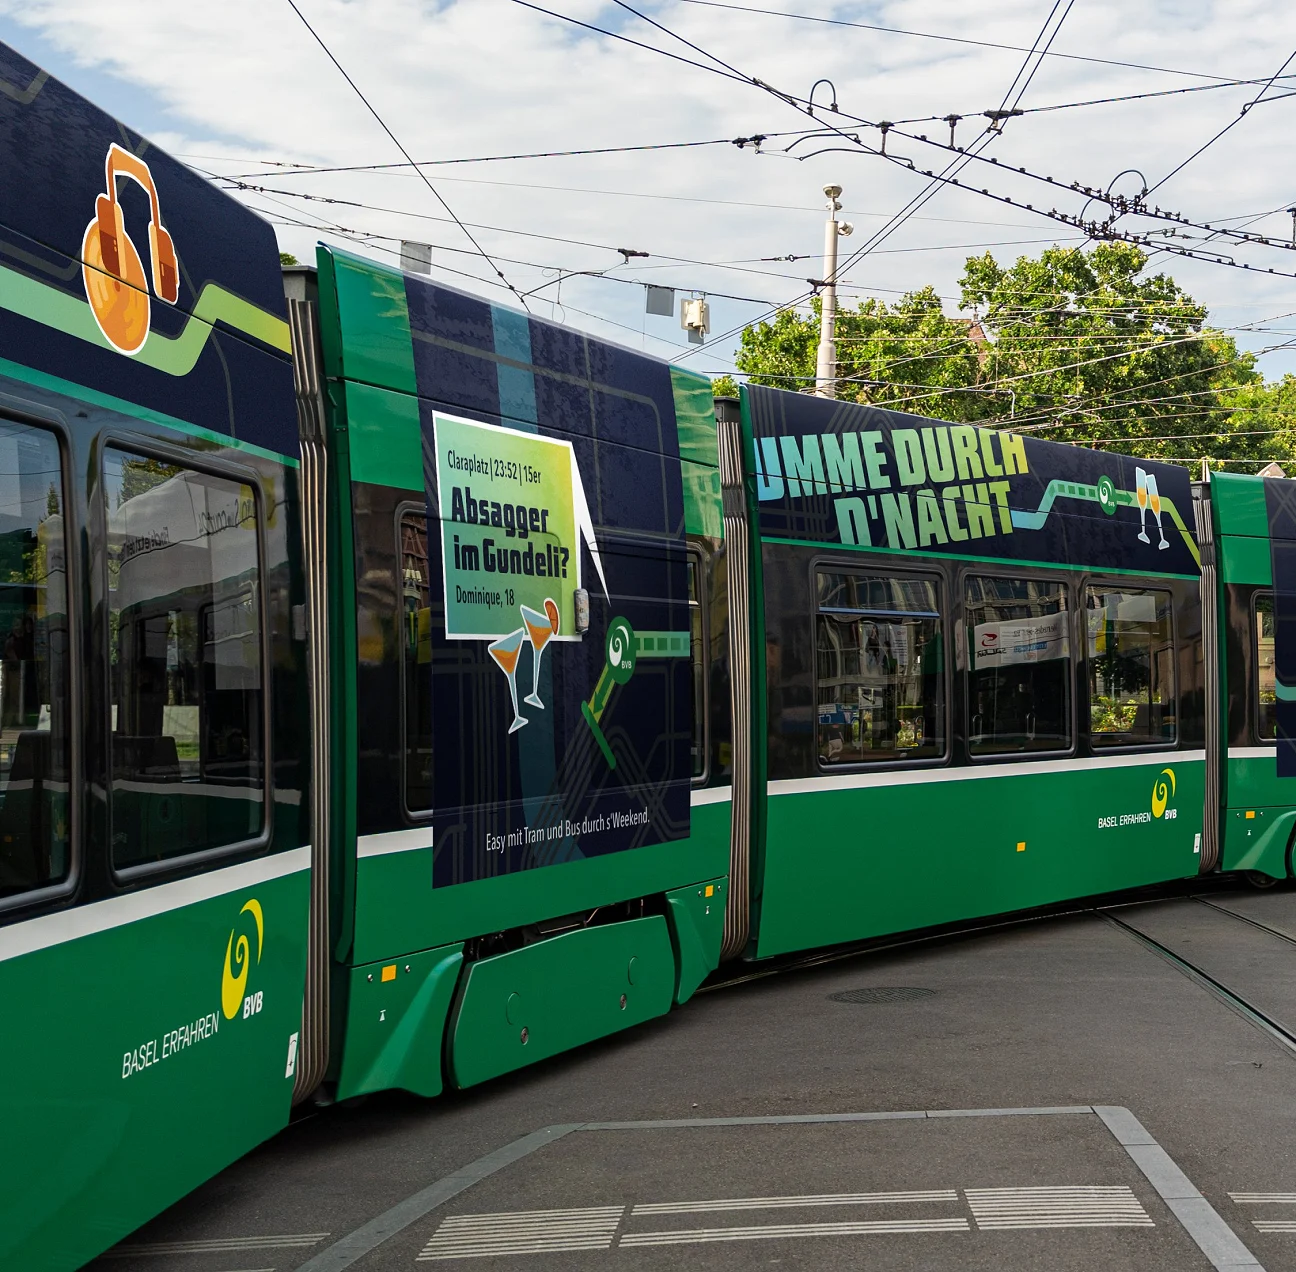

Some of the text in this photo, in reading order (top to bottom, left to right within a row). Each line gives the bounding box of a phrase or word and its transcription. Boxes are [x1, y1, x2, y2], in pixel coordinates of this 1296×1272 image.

[447, 450, 488, 477] Claraplatz
[494, 459, 518, 480] 23:52
[523, 465, 541, 484] 15er
[890, 425, 1030, 487] DURCH
[451, 486, 549, 539] Absagger
[833, 480, 1014, 550] D'NACHT
[453, 535, 570, 579] im Gundeli?
[456, 585, 515, 610] Dominique, 18
[621, 660, 632, 669] BVB
[486, 806, 650, 854] Easy mit Tram und Bus durch s'Weekend.
[1098, 808, 1177, 829] BASEL ERFAHREN BVB
[121, 990, 264, 1079] BASEL ERFAHREN BVB
